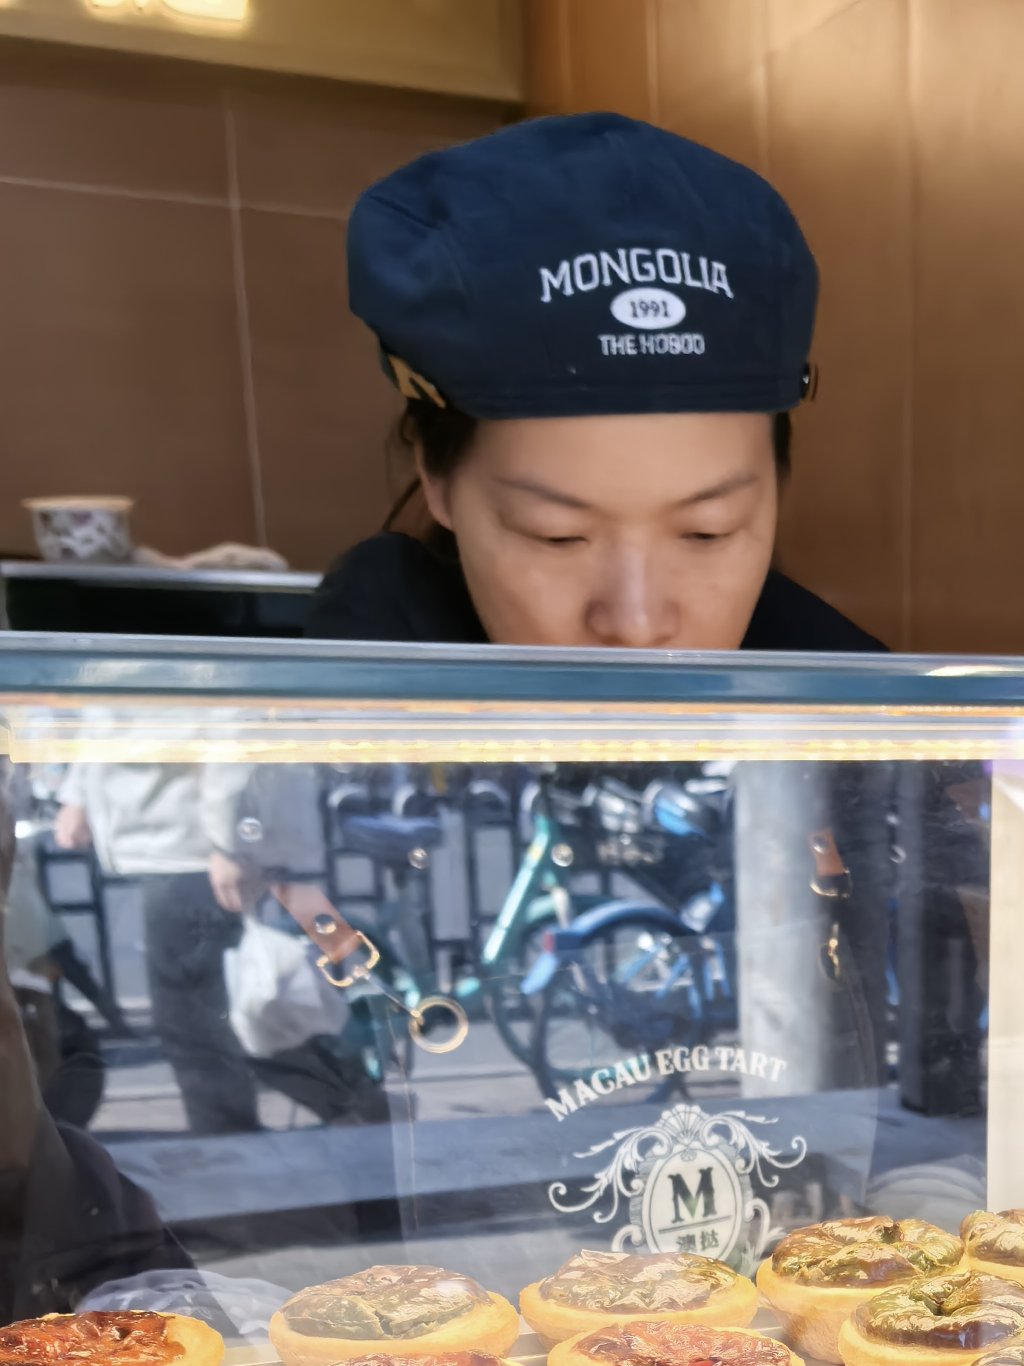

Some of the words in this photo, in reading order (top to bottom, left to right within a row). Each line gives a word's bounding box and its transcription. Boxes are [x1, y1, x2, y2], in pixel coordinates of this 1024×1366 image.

[540, 248, 733, 302] MONGOLIA
[630, 301, 670, 318] 1991
[599, 335, 637, 355] THE
[545, 1054, 651, 1122] MACAU
[656, 1046, 710, 1076] EGG
[714, 1046, 787, 1082] TART
[668, 1167, 718, 1223] M
